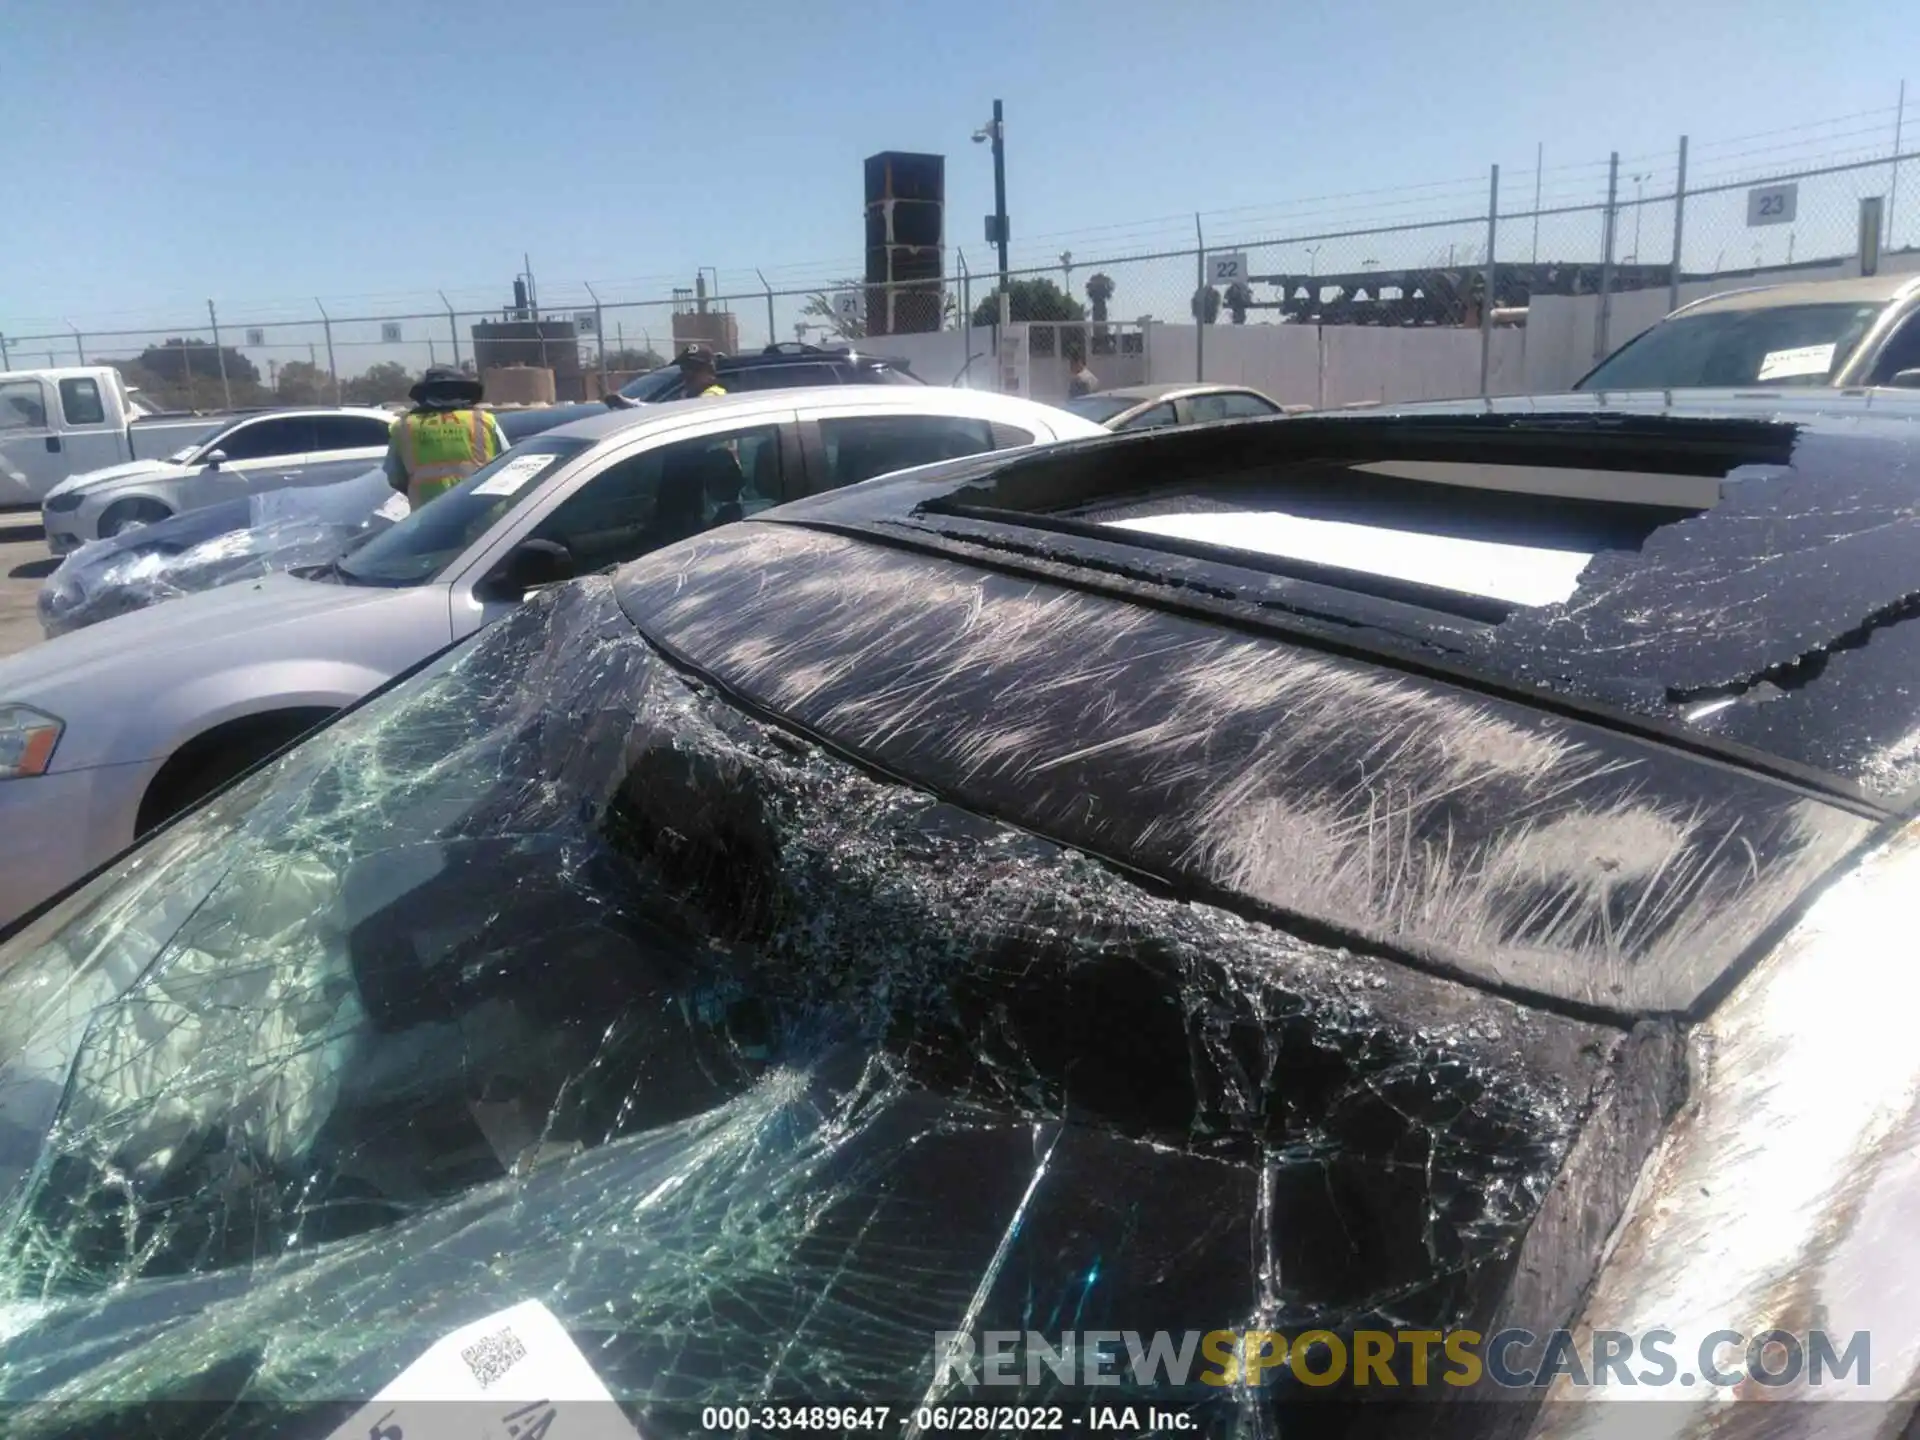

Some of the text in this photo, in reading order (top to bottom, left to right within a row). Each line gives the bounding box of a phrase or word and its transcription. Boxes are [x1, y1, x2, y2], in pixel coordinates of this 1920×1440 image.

[1758, 194, 1784, 216] 23
[1216, 261, 1238, 278] 22
[842, 298, 857, 312] 21
